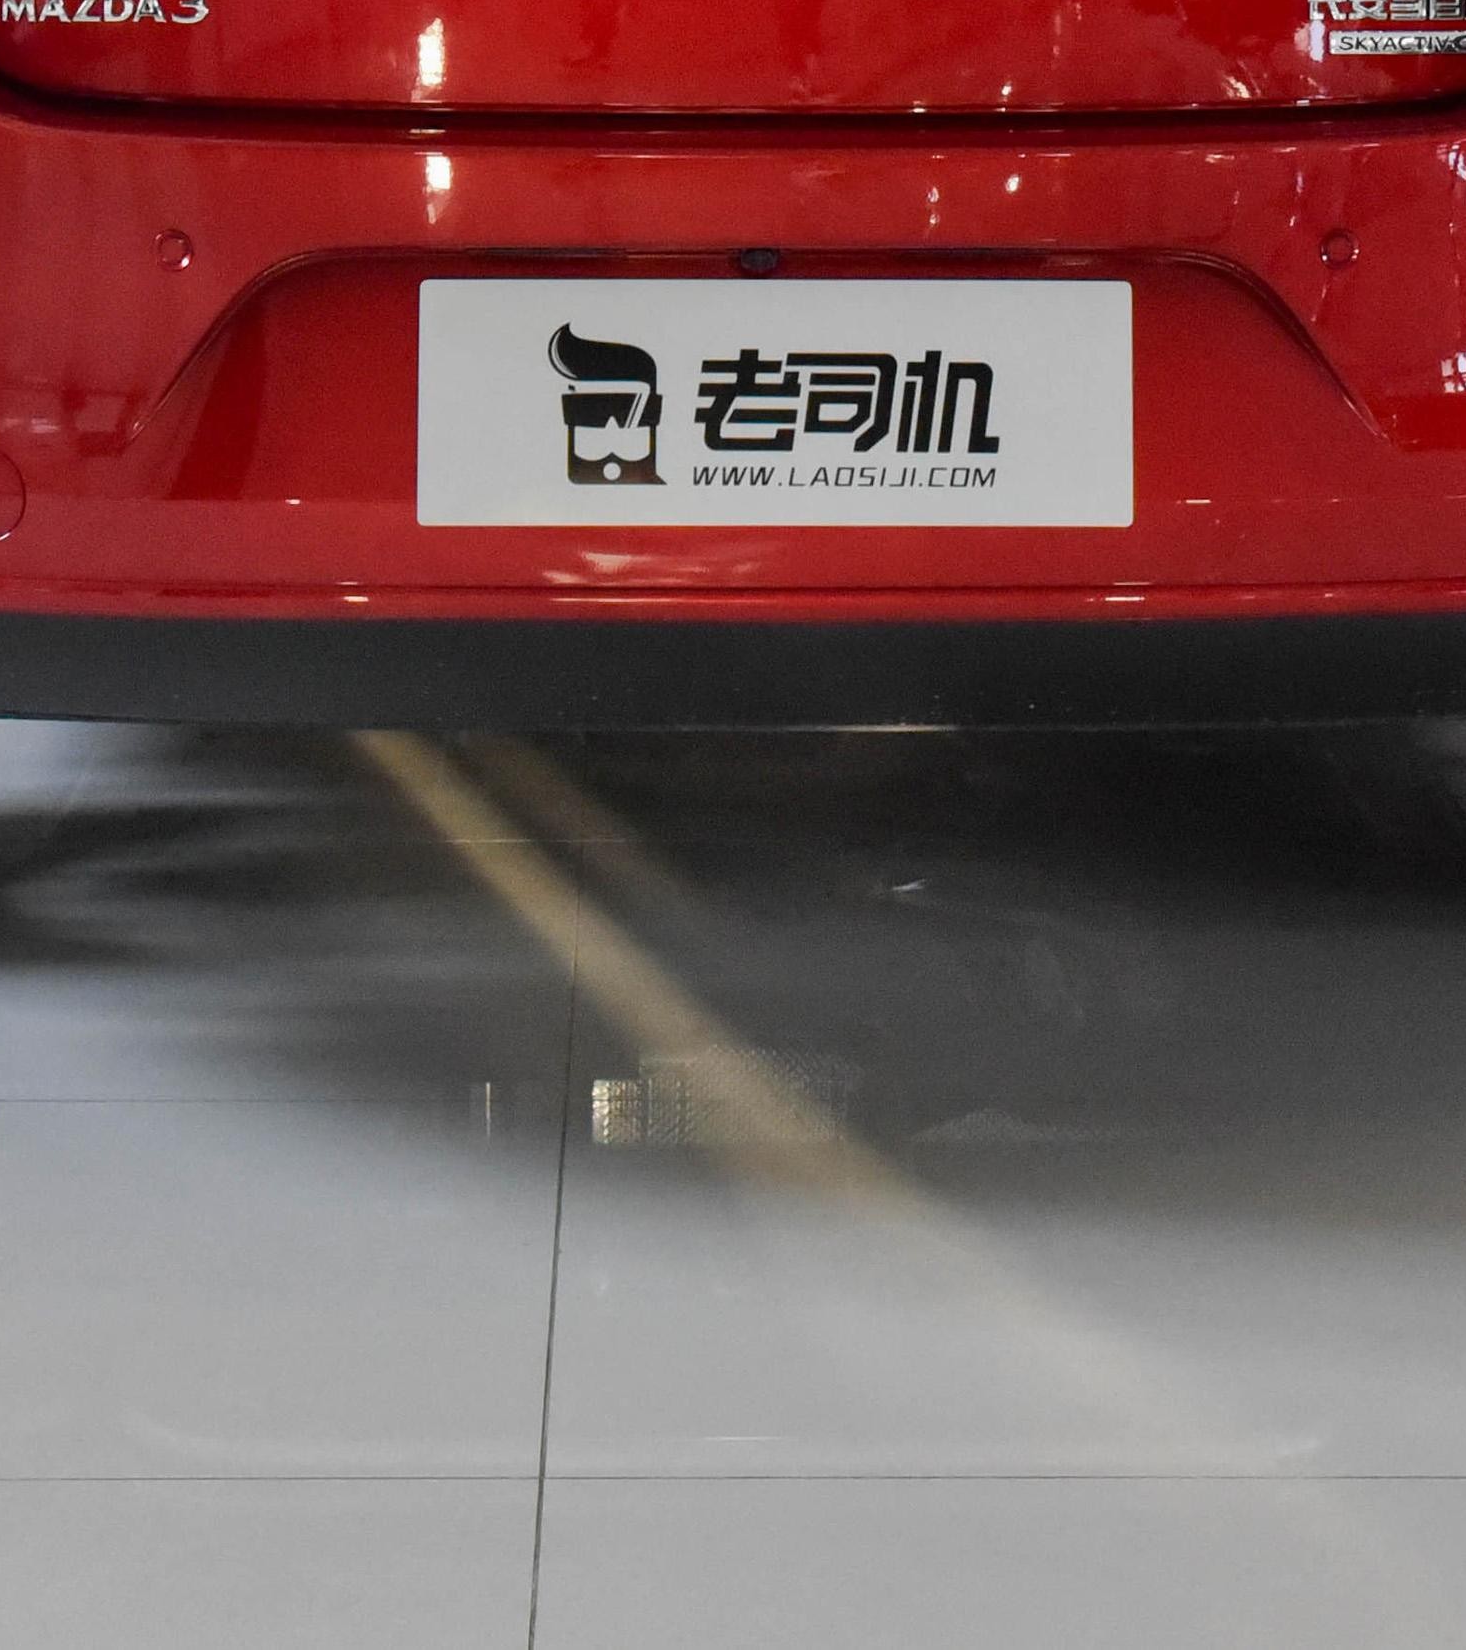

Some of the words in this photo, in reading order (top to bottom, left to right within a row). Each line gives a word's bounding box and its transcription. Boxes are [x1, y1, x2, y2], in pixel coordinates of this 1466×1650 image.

[693, 348, 1001, 454] 老司机
[692, 465, 997, 488] WWW.LAOSIJI.COM
